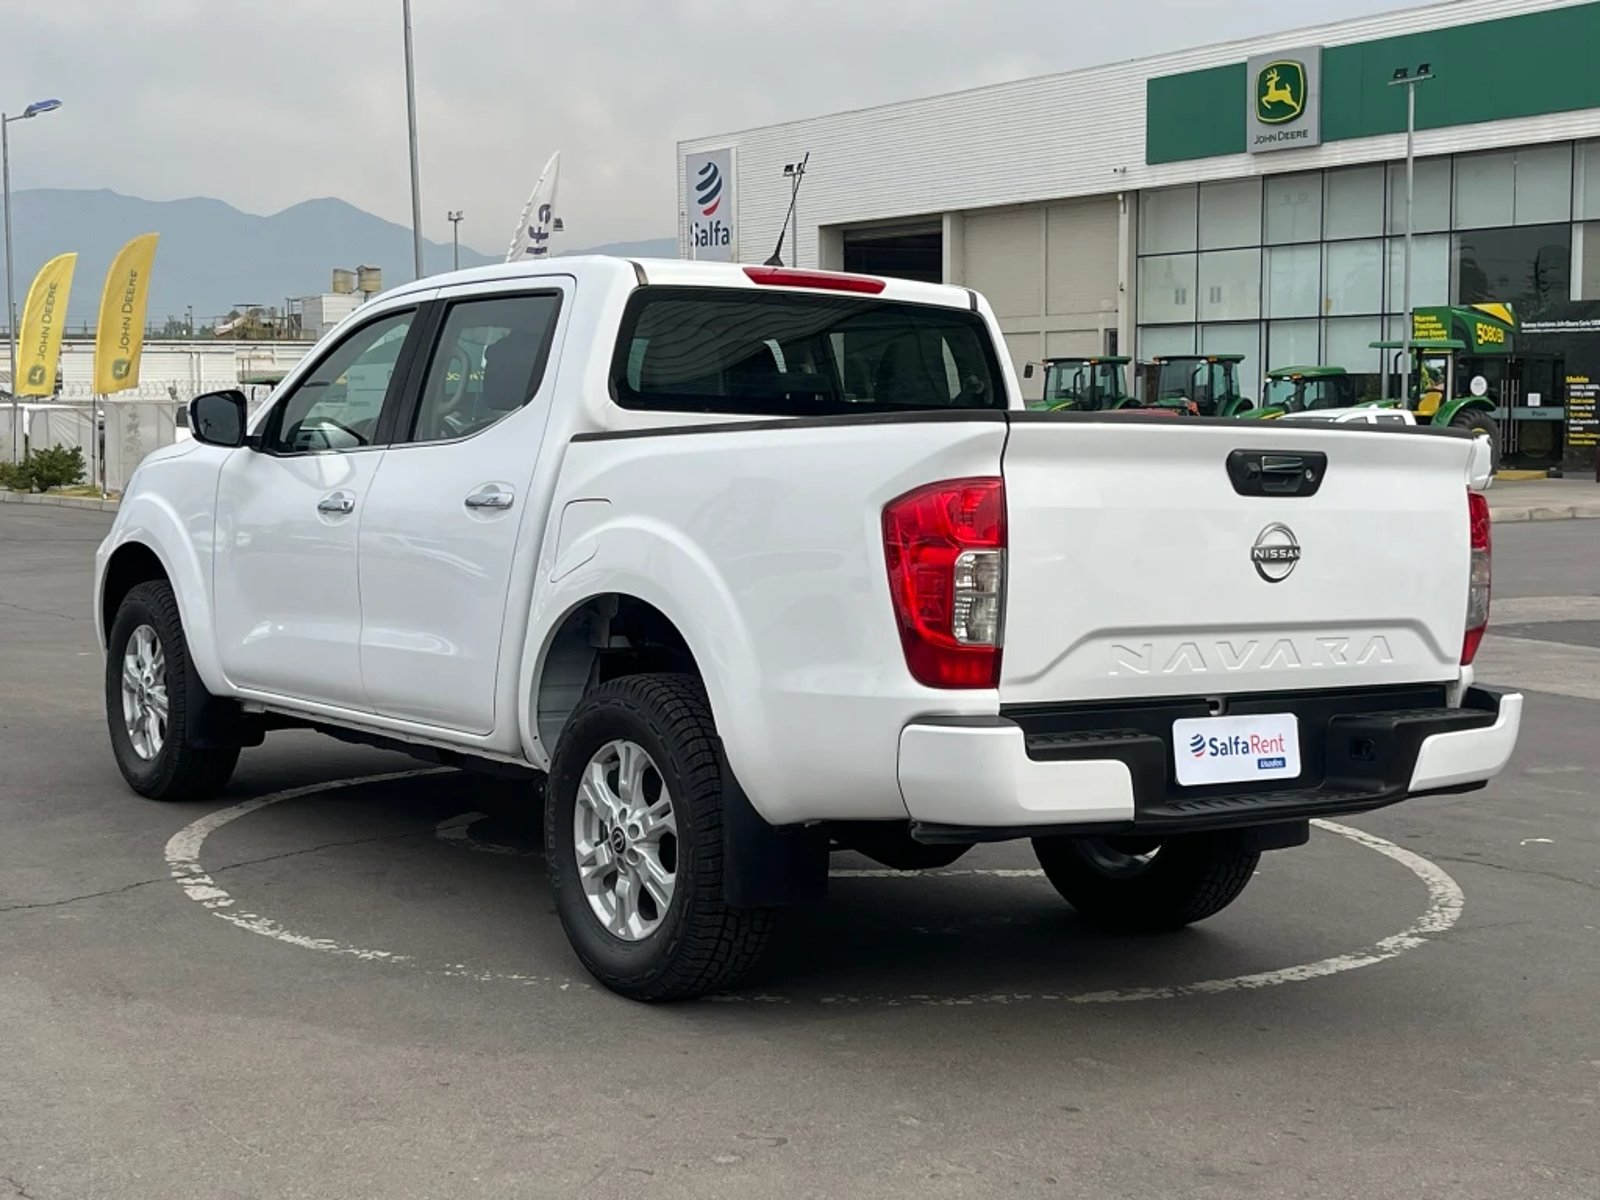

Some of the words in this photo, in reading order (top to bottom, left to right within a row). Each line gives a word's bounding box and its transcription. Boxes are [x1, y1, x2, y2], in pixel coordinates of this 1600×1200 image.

[1254, 133, 1277, 144] JOHN
[1278, 129, 1308, 141] DEERE
[690, 220, 731, 247] Salfa
[42, 281, 59, 324] DEERE
[122, 269, 139, 314] DEERE
[37, 326, 51, 361] JOHN
[118, 316, 132, 354] JOHN
[1254, 547, 1300, 560] NISSAN
[1108, 635, 1394, 676] NAVARA
[1208, 734, 1286, 757] SalfaRent
